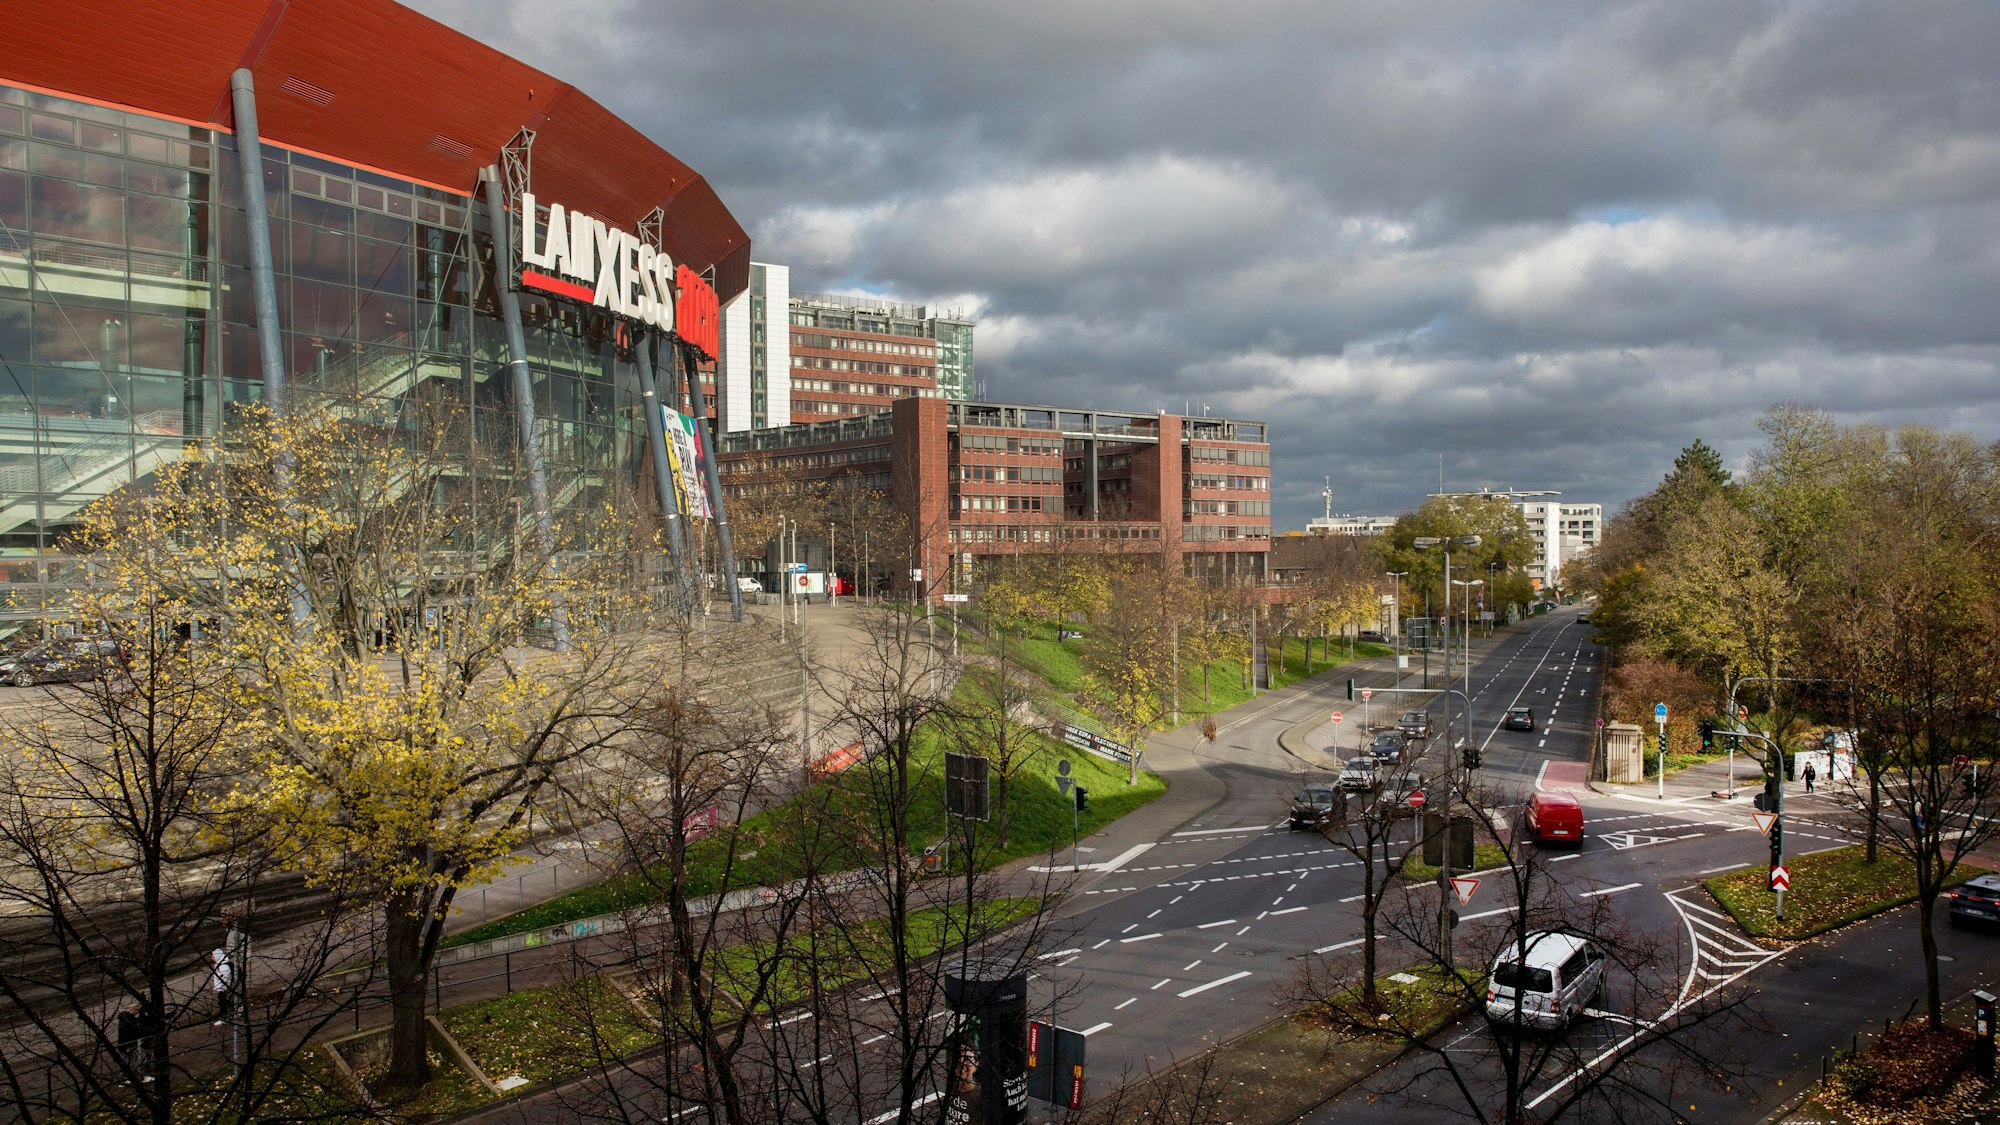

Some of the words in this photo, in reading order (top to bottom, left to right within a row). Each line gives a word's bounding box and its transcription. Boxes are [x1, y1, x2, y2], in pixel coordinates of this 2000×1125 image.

[522, 192, 674, 332] LANXESS
[1078, 729, 1092, 740] EZRA
[1094, 736, 1118, 750] ELECTRIC
[1117, 743, 1140, 758] CALLY
[1099, 746, 1115, 756] MARK
